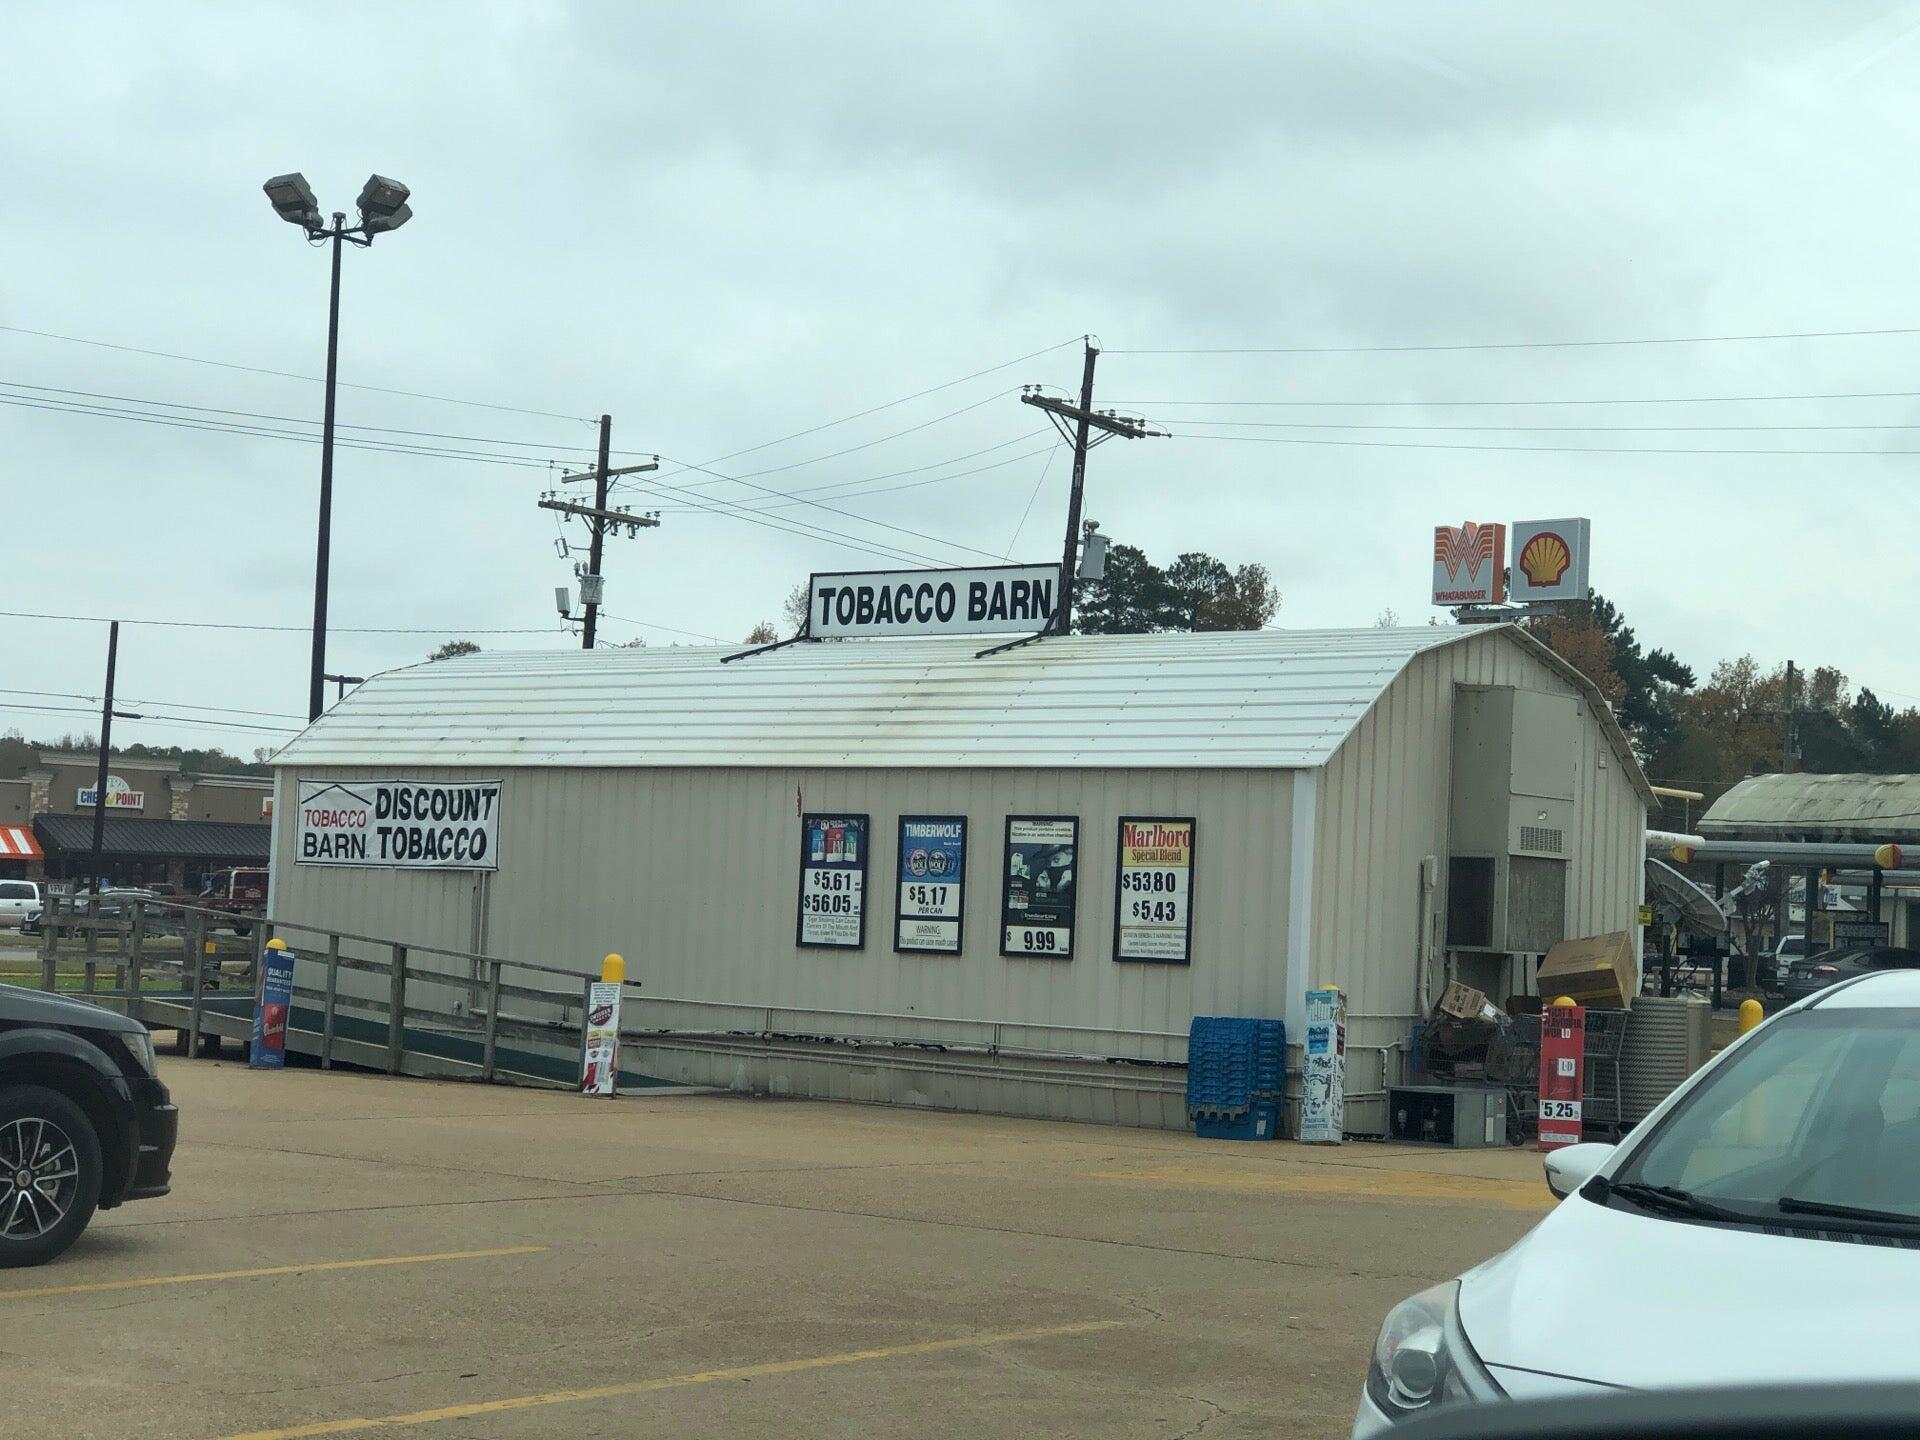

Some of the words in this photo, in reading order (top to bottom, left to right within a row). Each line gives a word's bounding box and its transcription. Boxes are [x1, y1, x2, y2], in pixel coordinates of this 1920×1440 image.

[818, 581, 956, 626] TOBACCO
[967, 579, 1052, 622] BARN
[1436, 590, 1486, 600] WHATABURGER
[116, 792, 142, 806] POINT
[374, 787, 498, 821] DISCOUNT
[304, 809, 367, 828] TOBACCO
[905, 824, 961, 838] TIMBERWOLF
[1124, 824, 1190, 848] Marlboro
[303, 832, 366, 860] BARN
[376, 826, 488, 861] TOBACCO
[1132, 849, 1158, 863] Special
[1160, 850, 1182, 861] Blend
[814, 871, 851, 891] $5.61
[1122, 872, 1176, 894] $53.80
[804, 894, 851, 914] $56.05
[909, 886, 948, 906] $5.17
[1132, 900, 1176, 922] $5.43
[1024, 930, 1056, 951] 9.99
[268, 968, 292, 978] QUALITY
